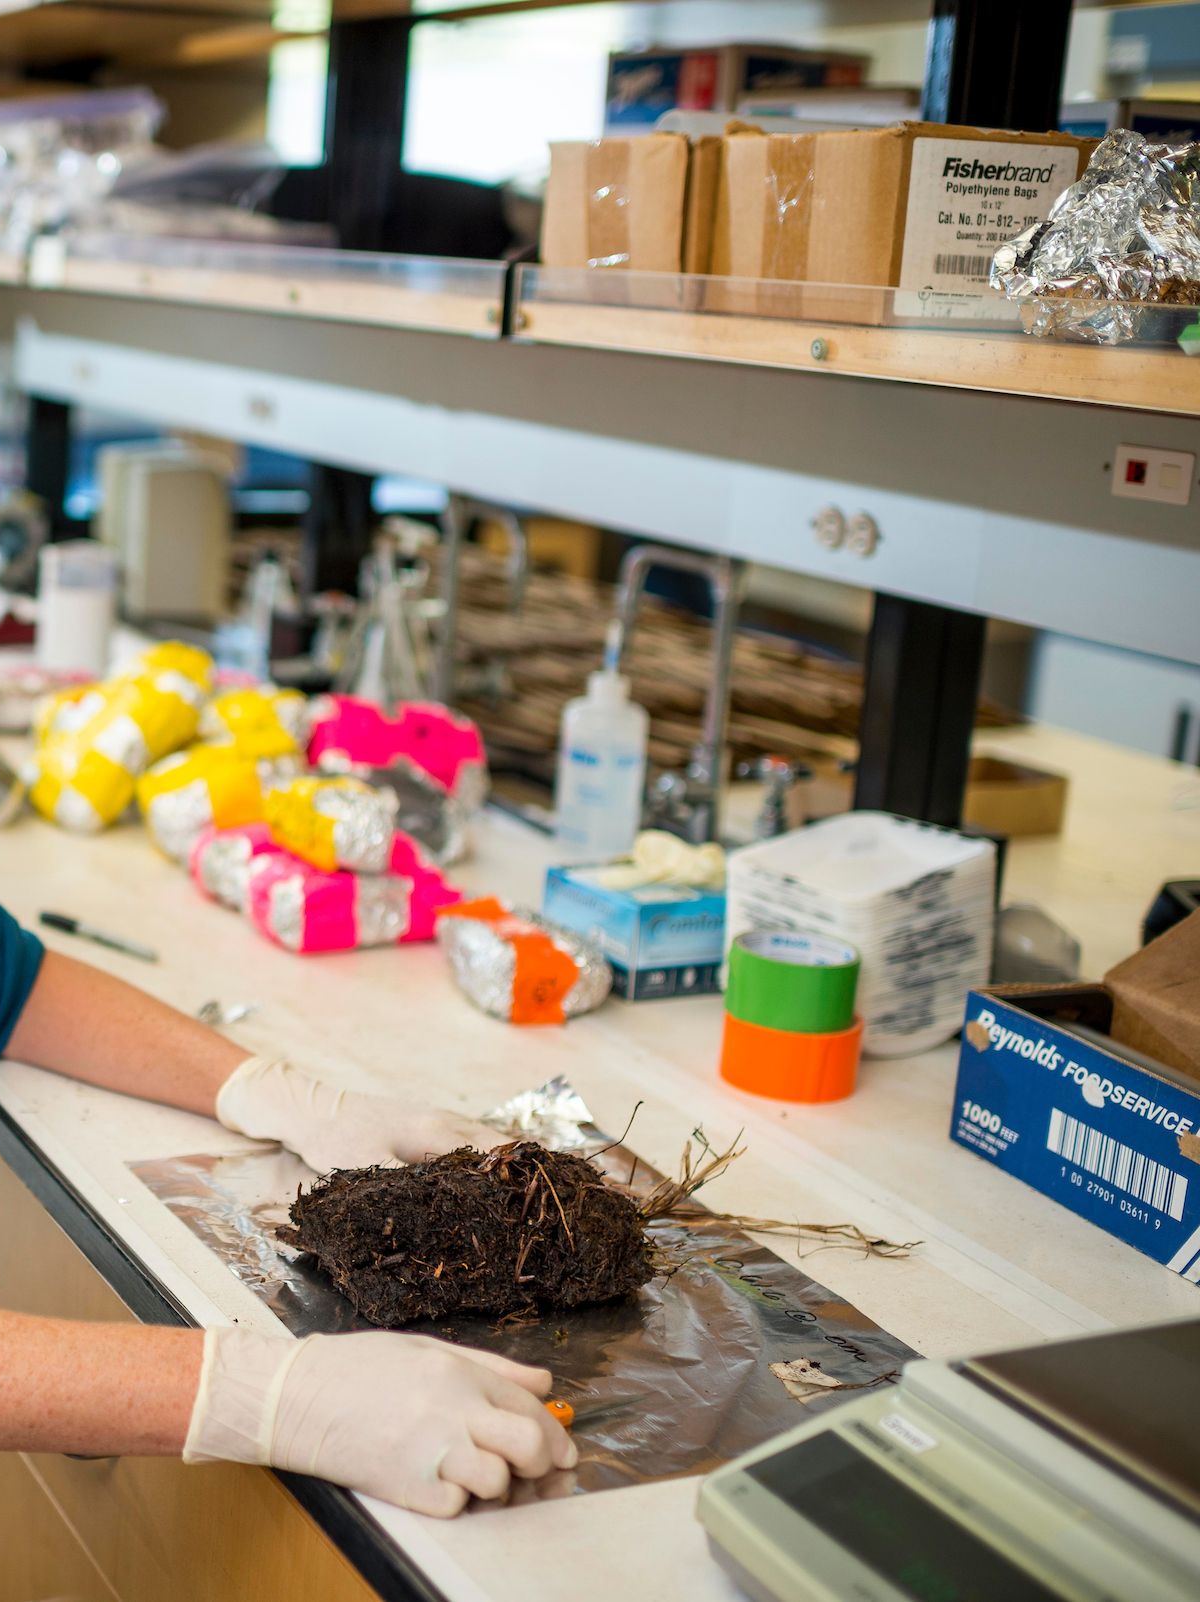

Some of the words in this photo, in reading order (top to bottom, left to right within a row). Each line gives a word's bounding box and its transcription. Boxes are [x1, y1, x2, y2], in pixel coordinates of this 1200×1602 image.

[942, 157, 1054, 183] Fisherbrand
[945, 181, 1010, 198] Polyethylene
[1013, 185, 1038, 200] Bags
[938, 211, 955, 225] Cat.
[958, 212, 973, 226] No.
[976, 1008, 1062, 1071] Reynolds
[962, 1100, 1002, 1134] 1000
[999, 1125, 1020, 1145] FEET
[1061, 1166, 1066, 1178] 1
[1070, 1171, 1083, 1187] 00
[1086, 1180, 1115, 1205] 27901
[1119, 1199, 1149, 1224] 03611
[1154, 1219, 1161, 1230] 9
